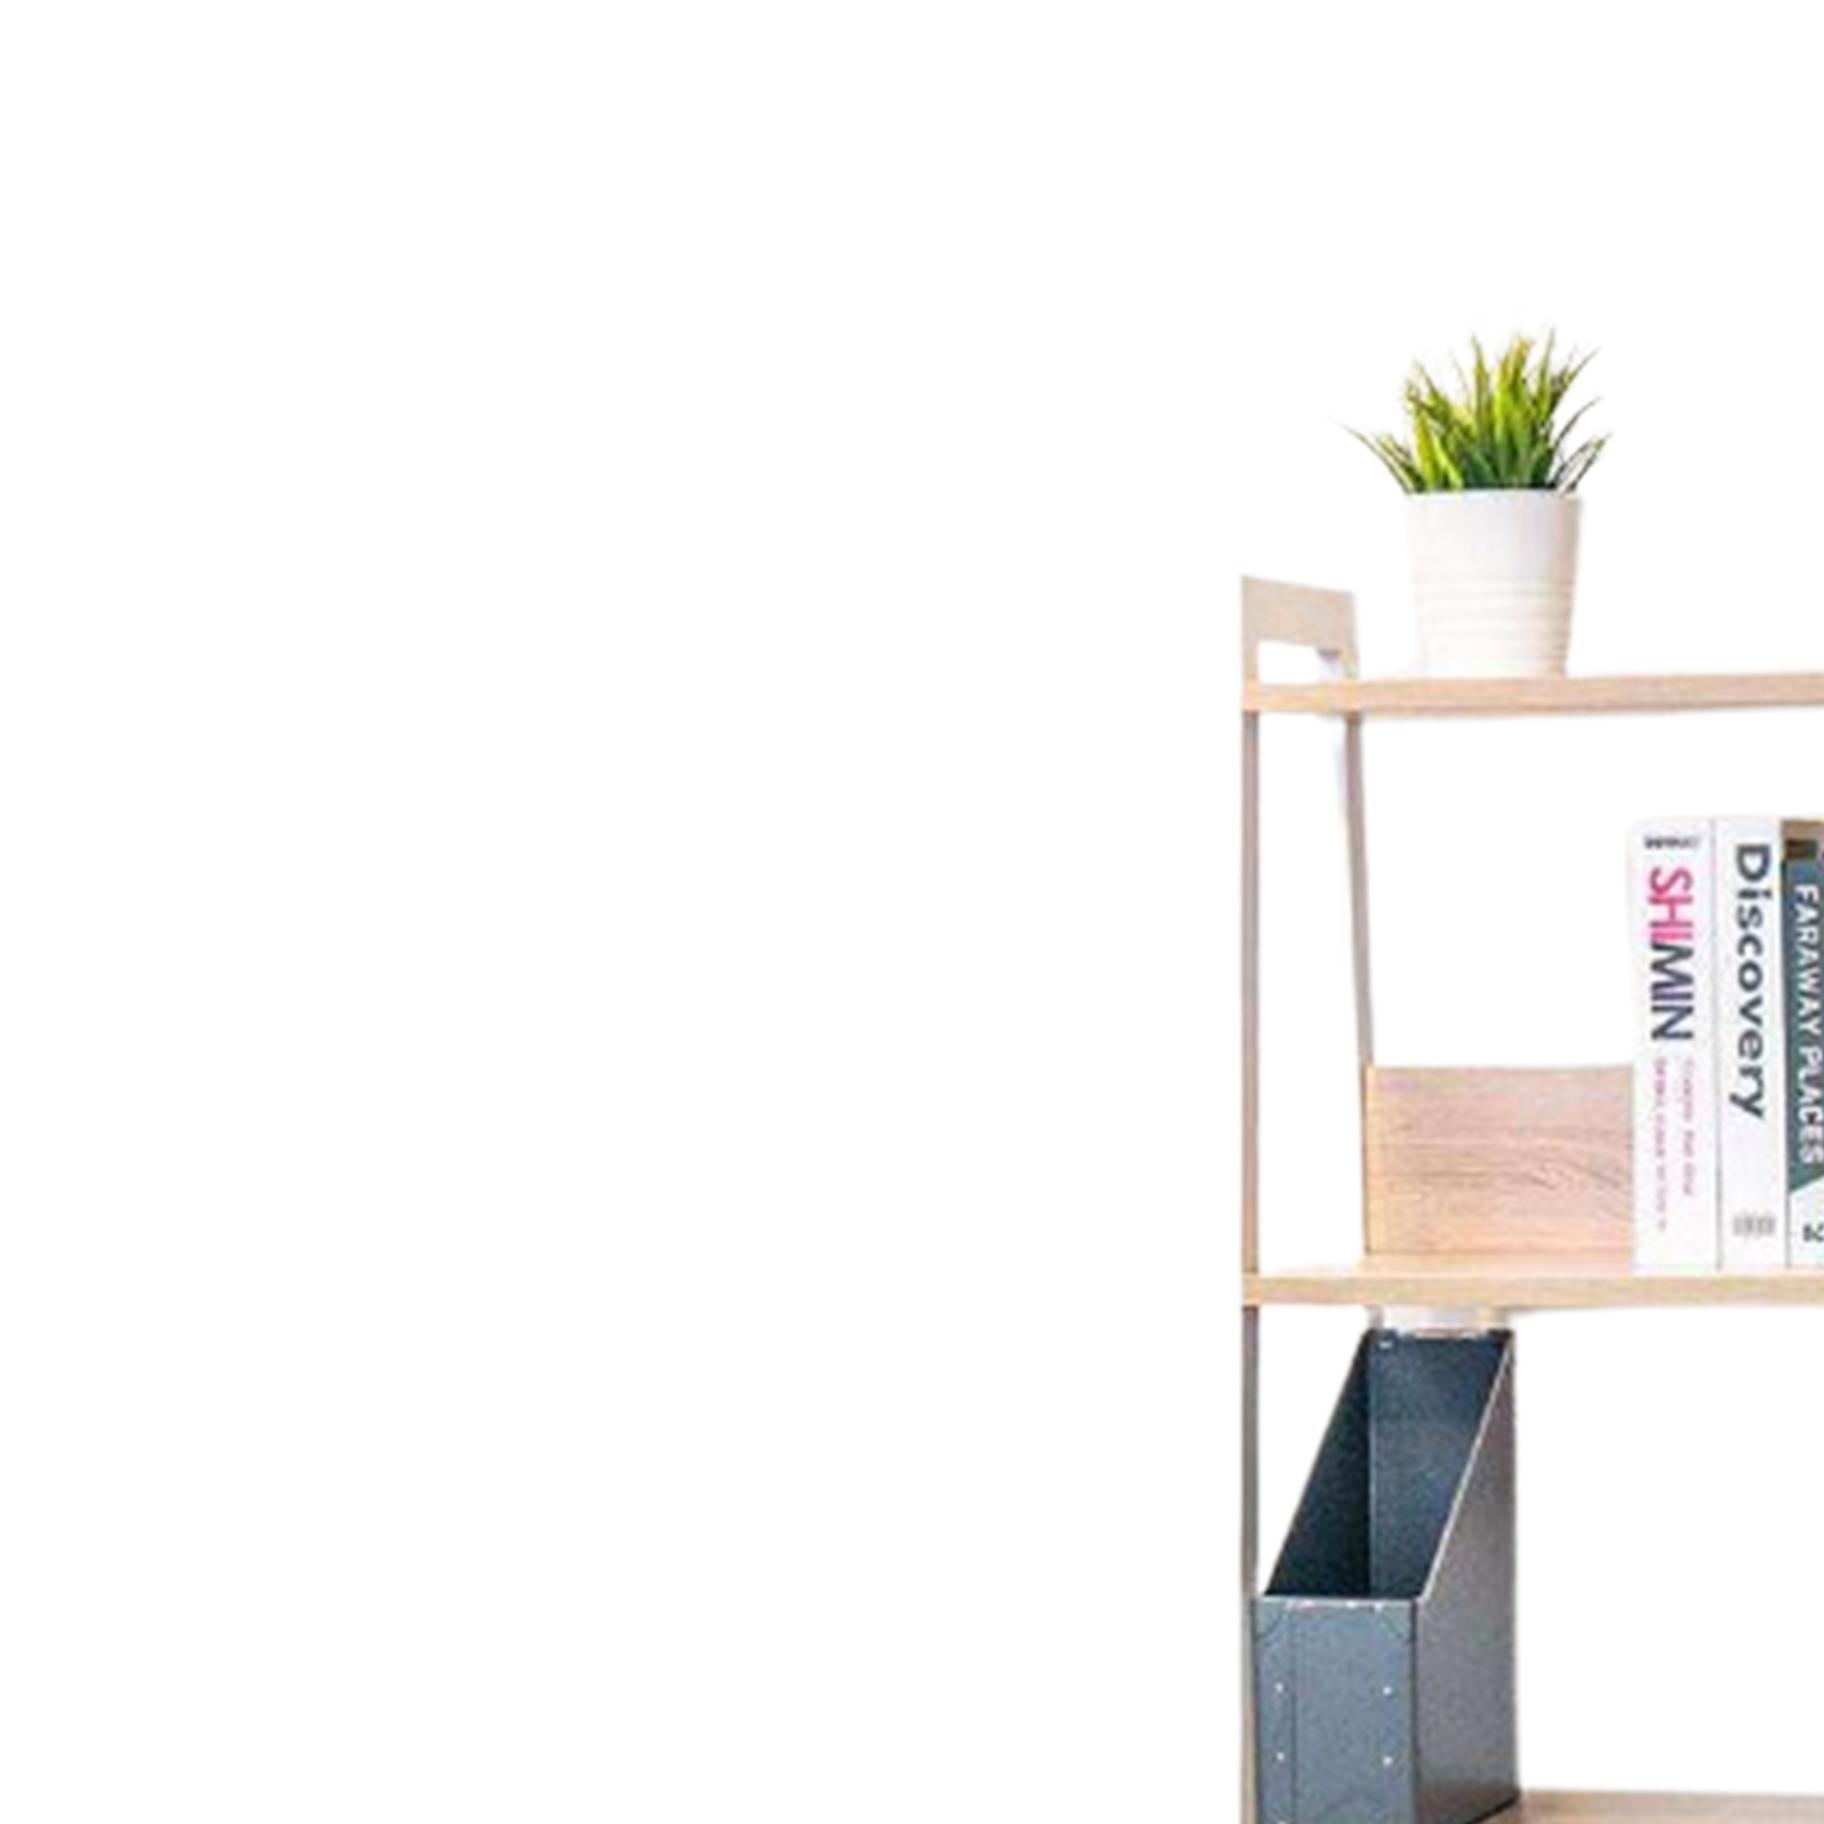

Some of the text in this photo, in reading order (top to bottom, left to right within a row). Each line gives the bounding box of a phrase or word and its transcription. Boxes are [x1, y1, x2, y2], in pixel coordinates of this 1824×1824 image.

[1647, 866, 1696, 1042] SHIMIN
[1730, 843, 1772, 1119] Discovery
[1794, 884, 1824, 1164] FARAWAY PLACES
